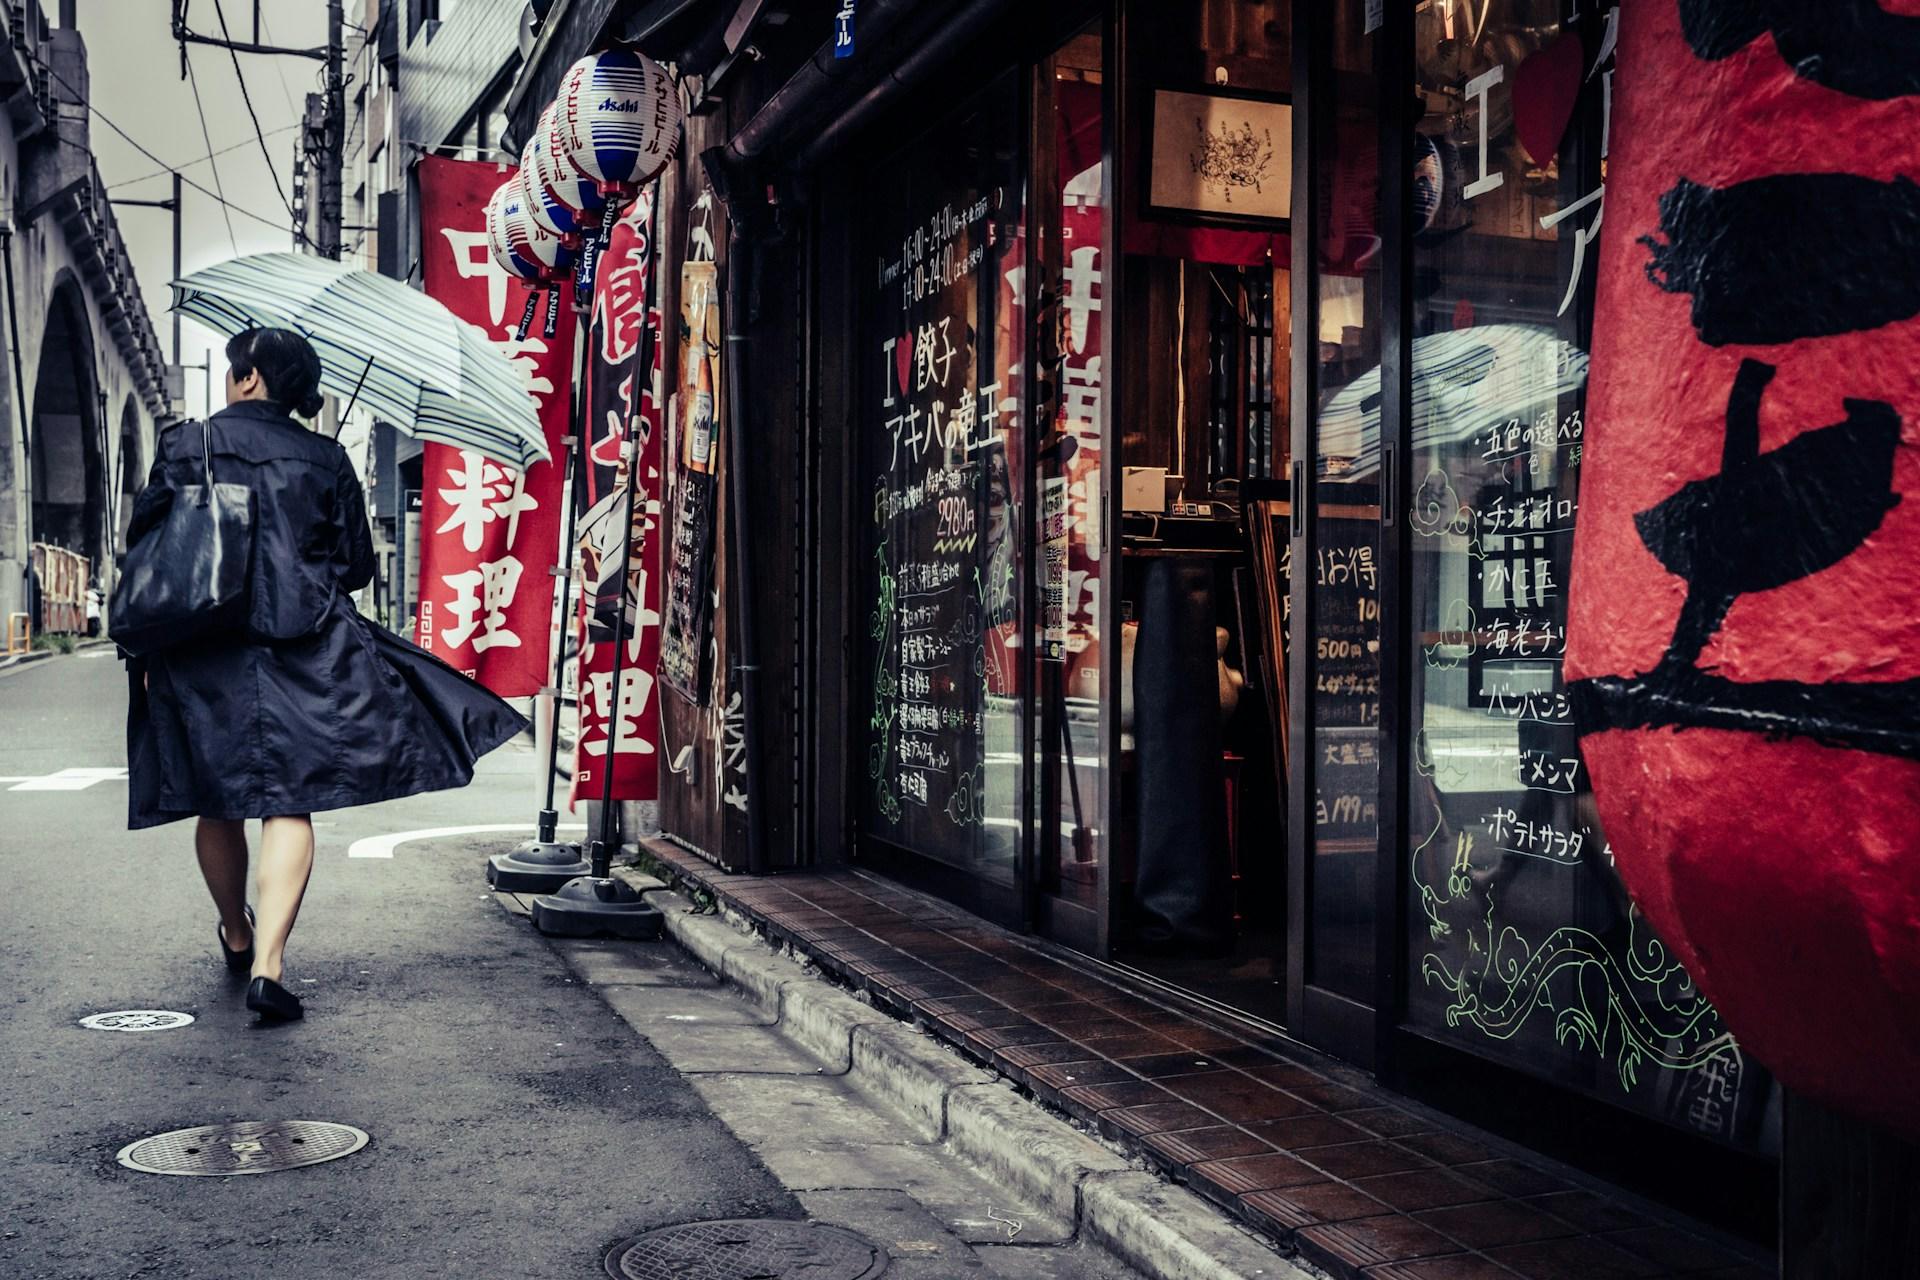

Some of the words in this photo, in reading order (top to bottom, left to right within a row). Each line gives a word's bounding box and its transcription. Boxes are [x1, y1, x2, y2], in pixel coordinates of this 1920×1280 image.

[567, 67, 585, 150] アサヒビール
[598, 97, 640, 114] Asahi
[645, 72, 668, 154] アサヒビール
[914, 316, 957, 392] 餃子
[1481, 409, 1583, 458] 五色の選べる
[1488, 560, 1558, 593] かに玉
[1485, 617, 1568, 656] 海老チリ
[1494, 745, 1580, 793] ギメンマ
[1488, 806, 1592, 858] ポテトサラダ
